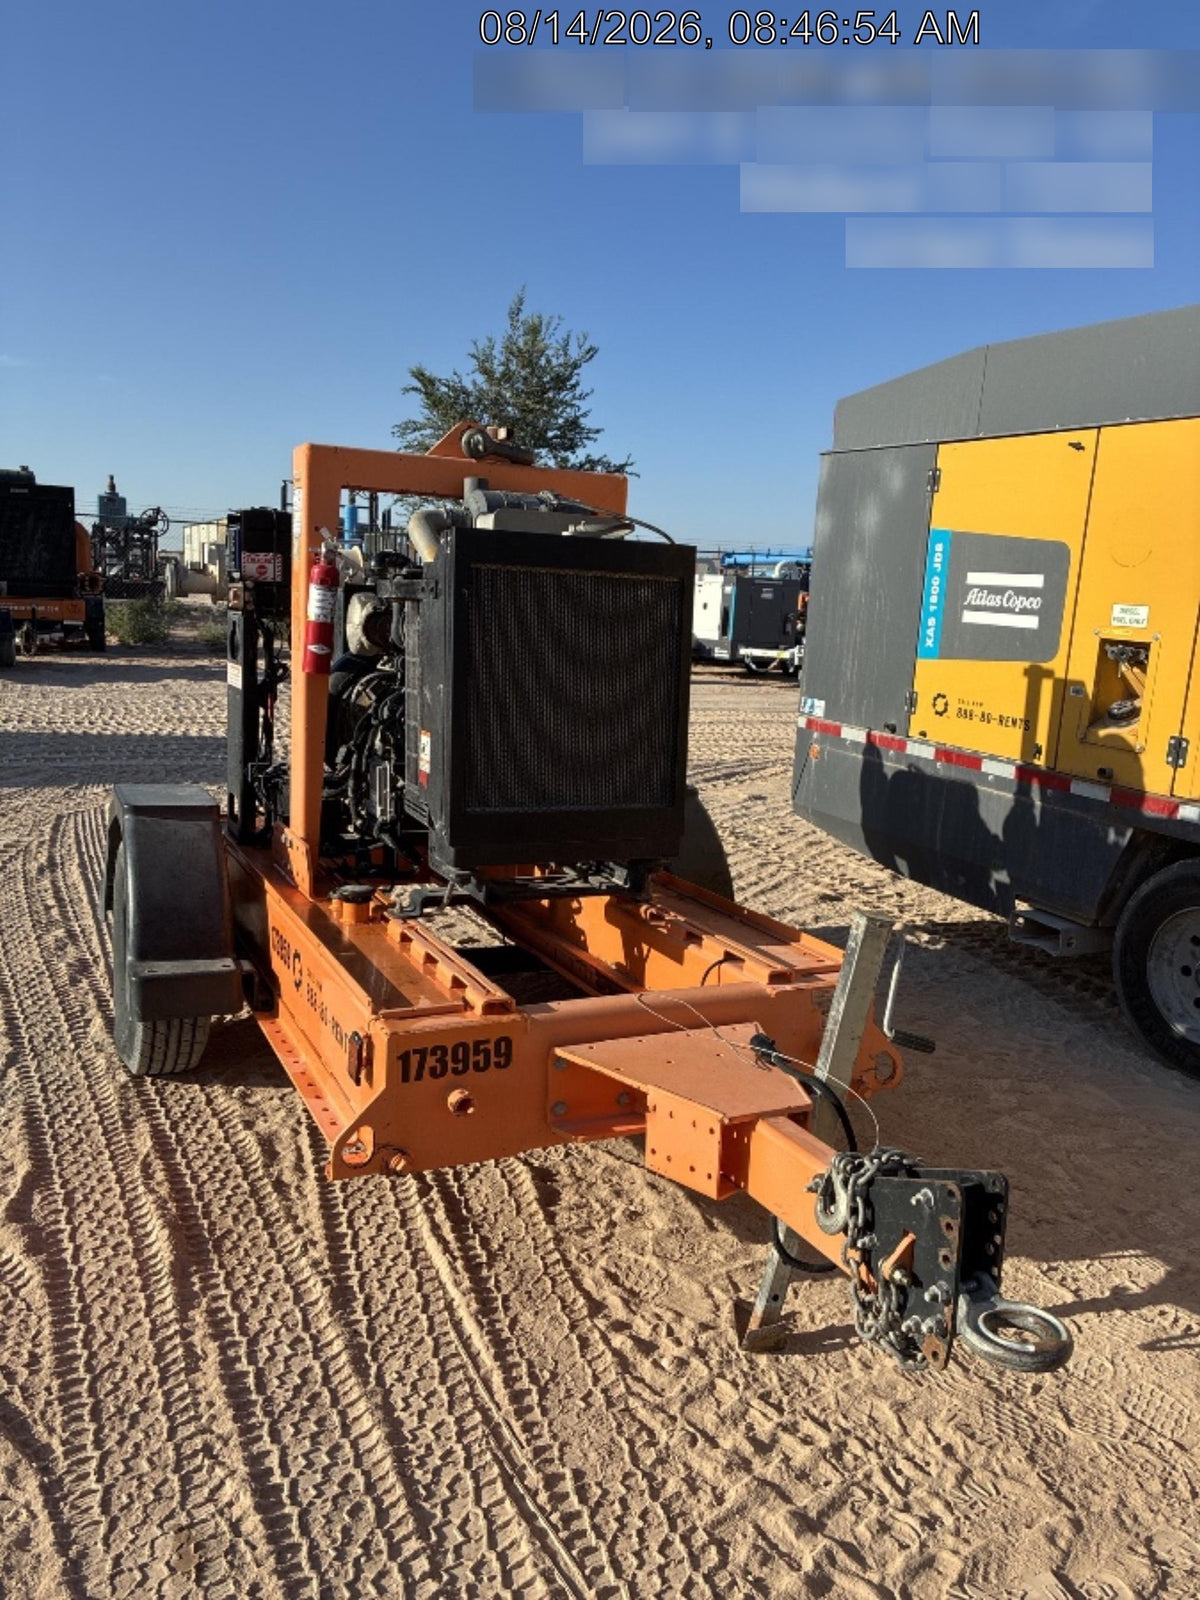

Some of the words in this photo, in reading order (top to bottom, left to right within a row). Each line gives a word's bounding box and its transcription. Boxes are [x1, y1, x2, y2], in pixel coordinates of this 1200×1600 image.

[929, 575, 940, 612] 1800
[925, 616, 936, 648] XAS
[396, 1035, 513, 1083] 173959
